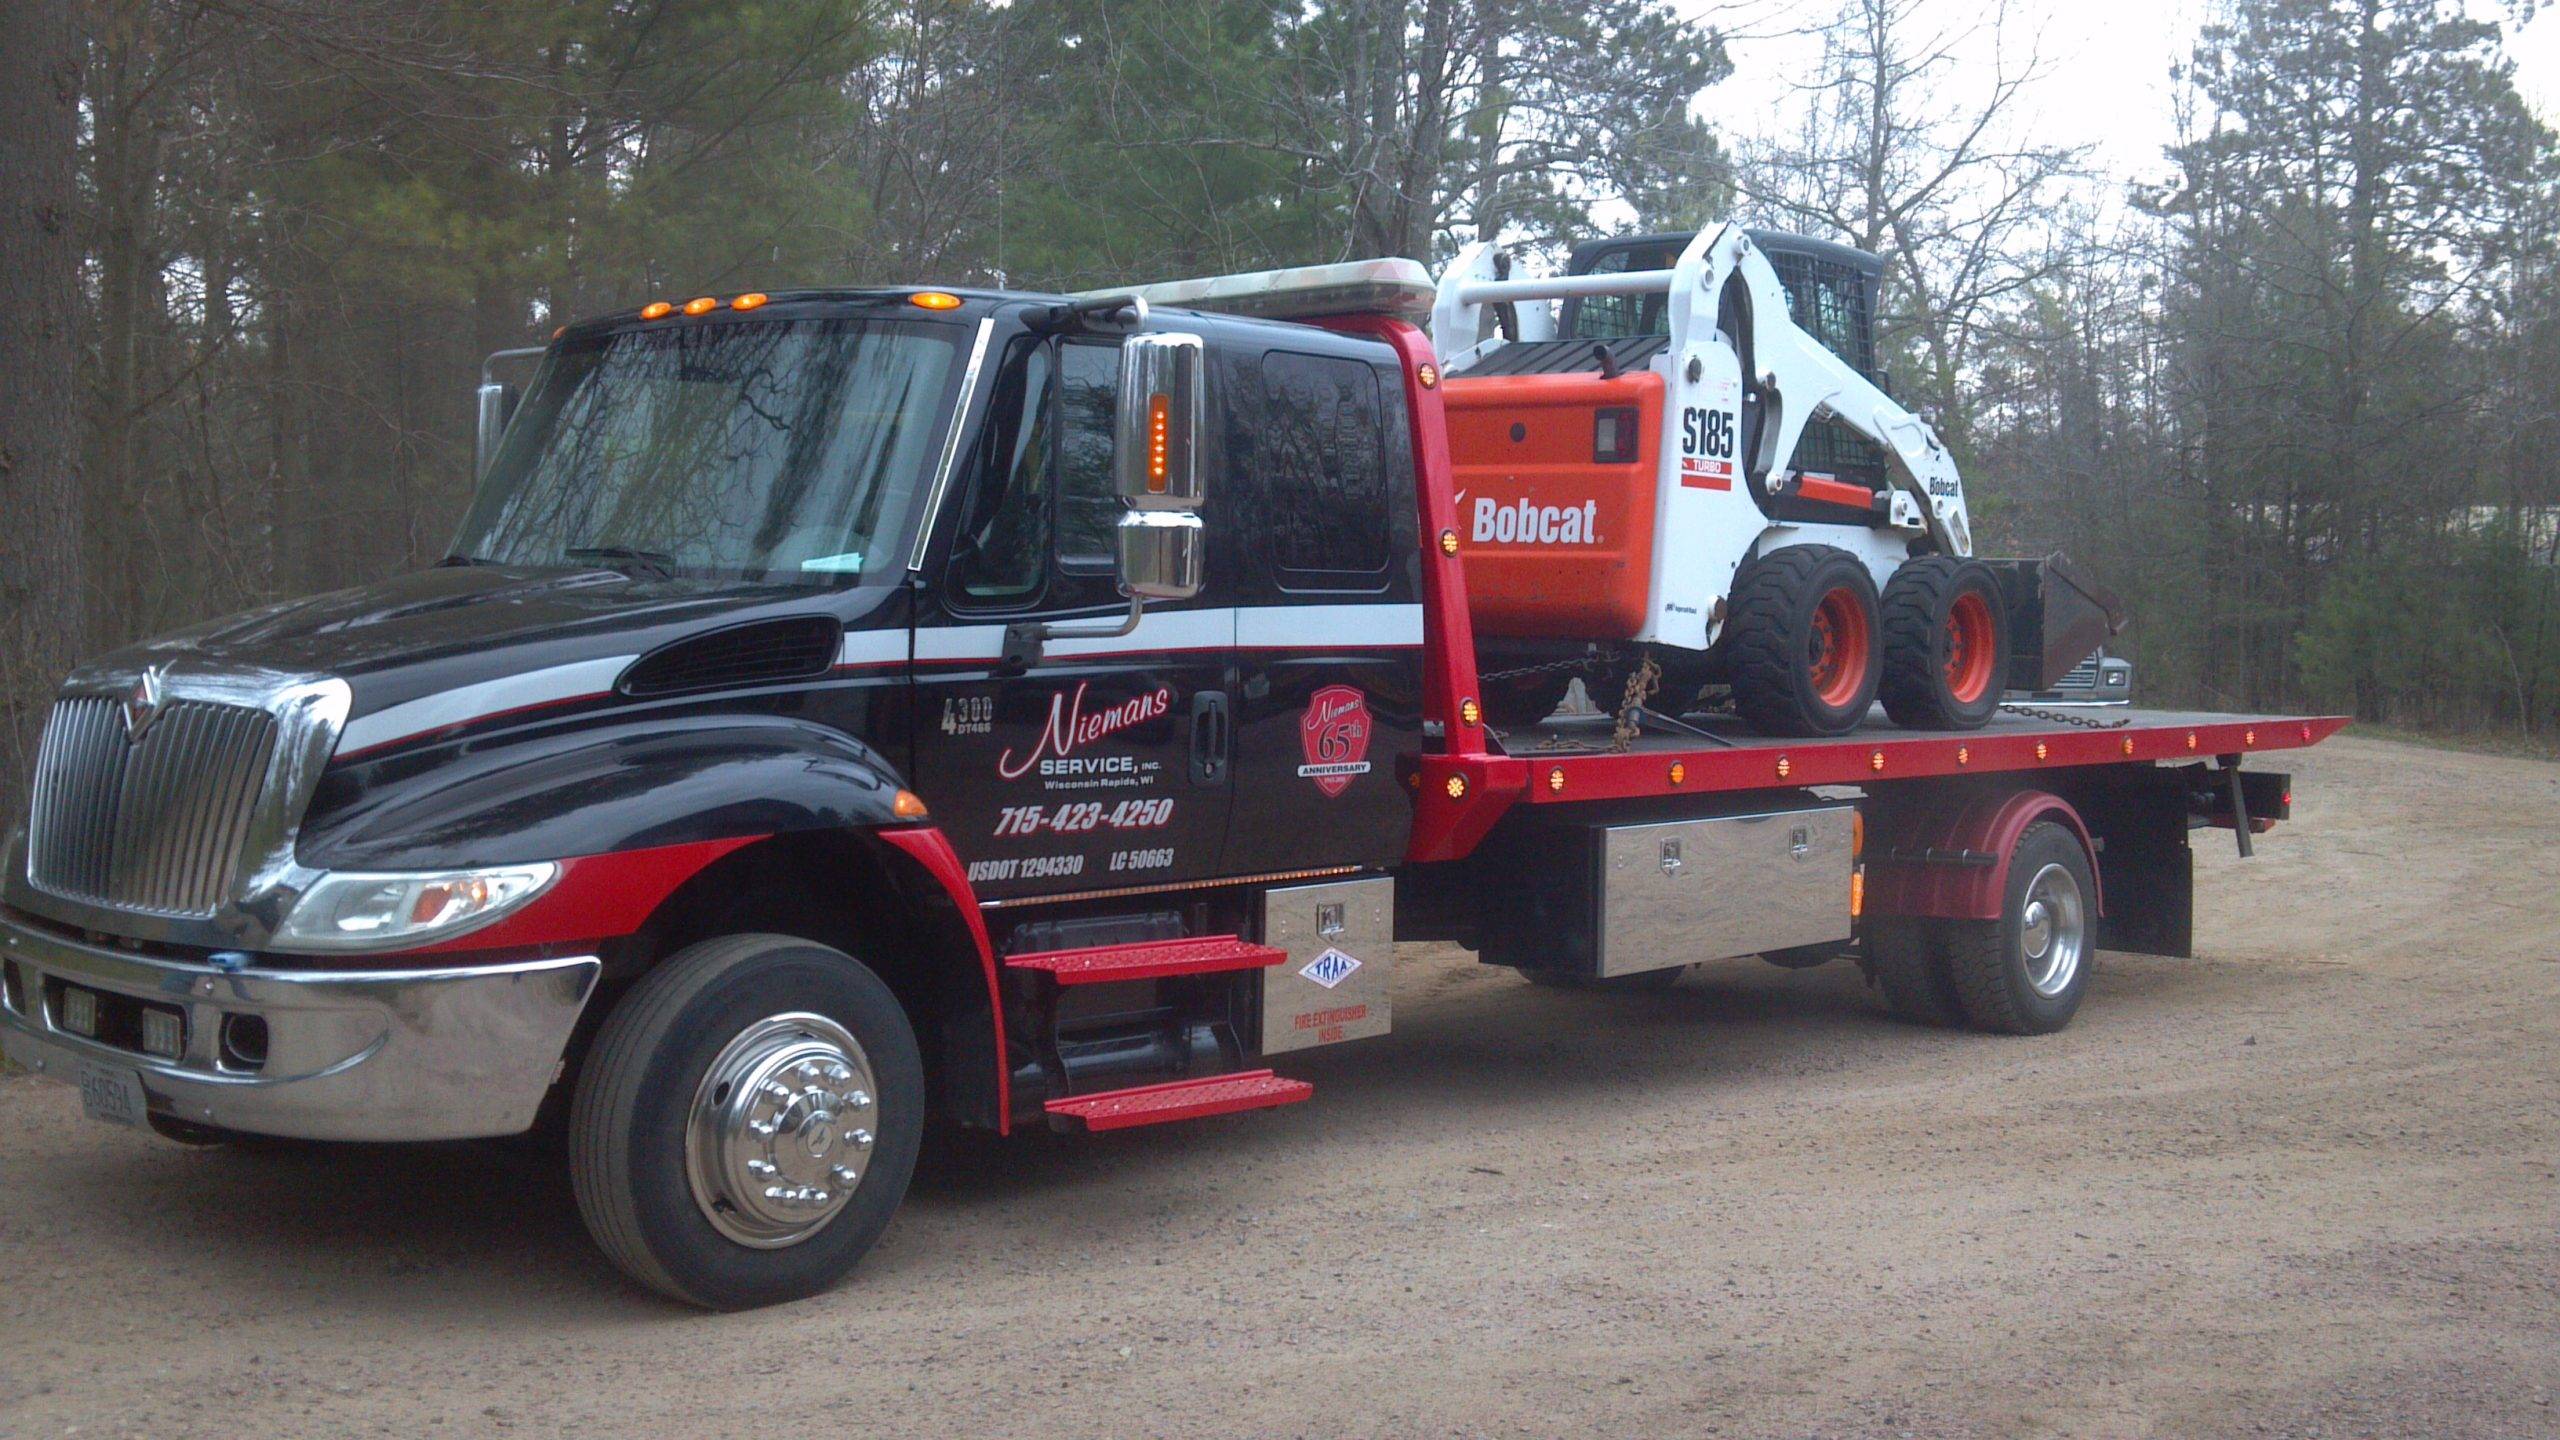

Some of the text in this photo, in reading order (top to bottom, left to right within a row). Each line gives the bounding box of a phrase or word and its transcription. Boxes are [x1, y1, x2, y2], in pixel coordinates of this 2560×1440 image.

[1682, 406, 1734, 459] S185
[1693, 459, 1722, 473] TURBO
[1930, 476, 1958, 498] Bobcat
[1472, 497, 1597, 544] Bobcat
[941, 696, 993, 735] 4300
[999, 682, 1168, 778] Niemans
[1040, 757, 1162, 775] SERVICE, INC.
[1302, 763, 1367, 775] ANNIVERSARY
[1045, 780, 1099, 790] Wisconsin
[1140, 775, 1154, 785] WI
[993, 798, 1174, 836] 715-423-4250
[968, 854, 1084, 882] USDOT 1294330
[1109, 848, 1174, 871] LC 50663
[1316, 955, 1348, 980] TRAA
[1295, 1013, 1311, 1030] FIRE
